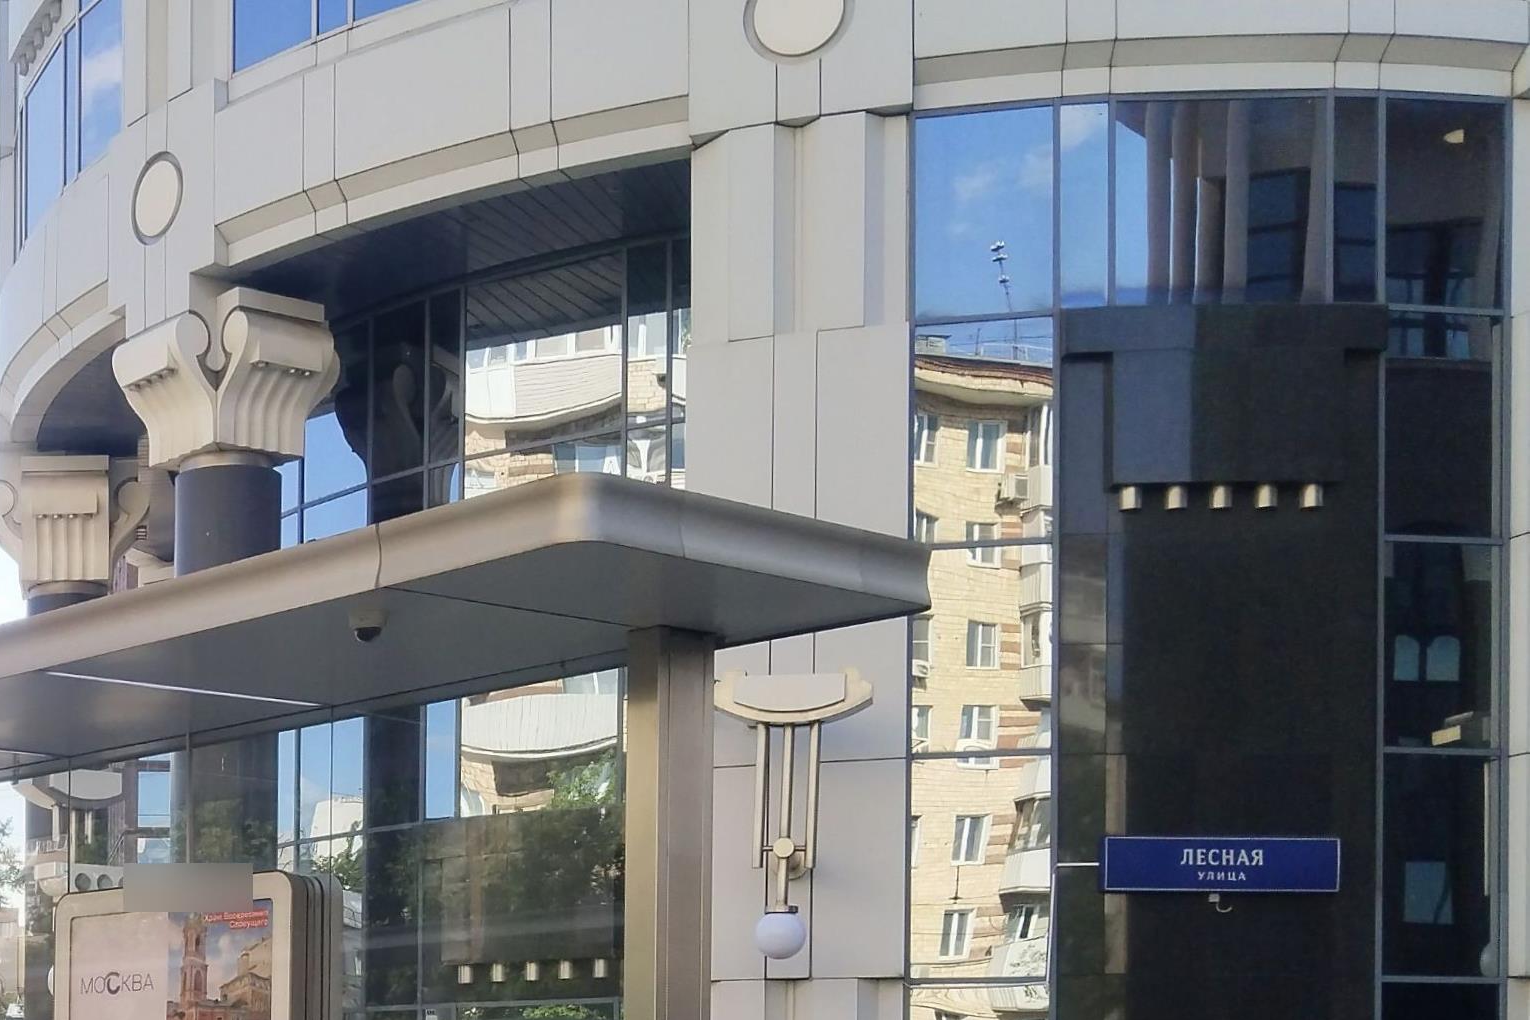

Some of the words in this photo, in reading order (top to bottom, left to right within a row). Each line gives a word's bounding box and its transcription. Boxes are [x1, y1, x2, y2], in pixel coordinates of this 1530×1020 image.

[1180, 848, 1264, 866] ЛЕСНАЯ
[1197, 871, 1246, 882] УЛИЦА
[80, 971, 154, 995] МОСКВА
